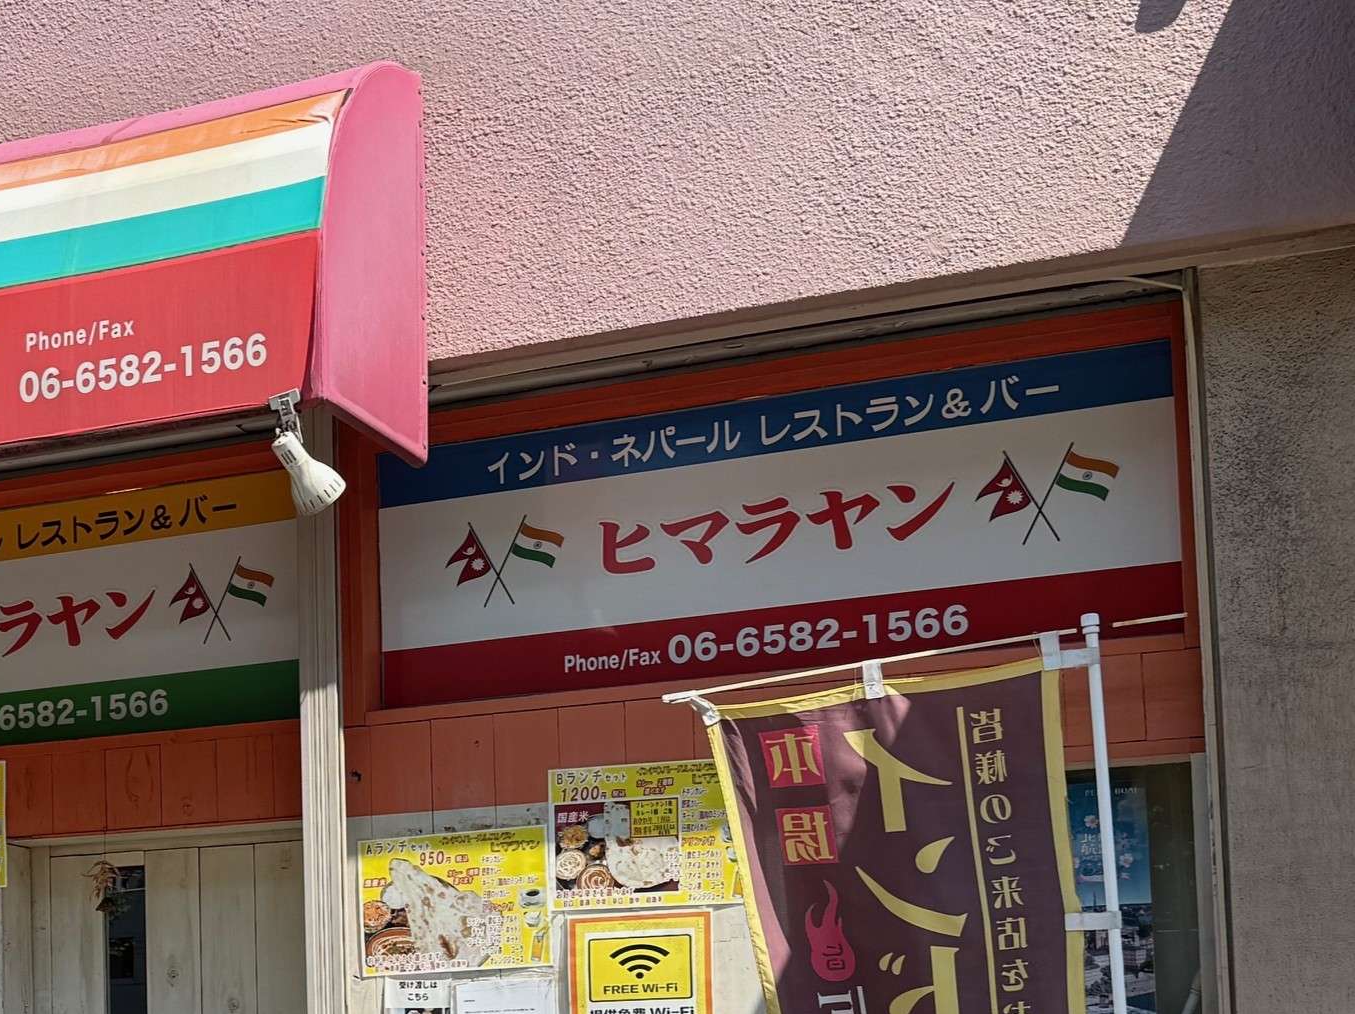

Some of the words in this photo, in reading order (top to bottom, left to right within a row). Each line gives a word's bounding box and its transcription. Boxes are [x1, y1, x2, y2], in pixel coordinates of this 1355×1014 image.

[25, 319, 134, 352] Phone/Fax
[18, 333, 268, 404] 06-6582-1566
[487, 426, 741, 485] インド・ネパール
[598, 480, 957, 576] ヒマラヤン
[563, 650, 662, 674] Phone/Fax
[667, 606, 970, 666] 06-6582-1566
[557, 811, 589, 824] 国産米
[398, 981, 438, 990] 受け渡しは
[407, 993, 429, 1001] こちら
[603, 984, 638, 995] FREE
[643, 982, 678, 993] Wi-Fi
